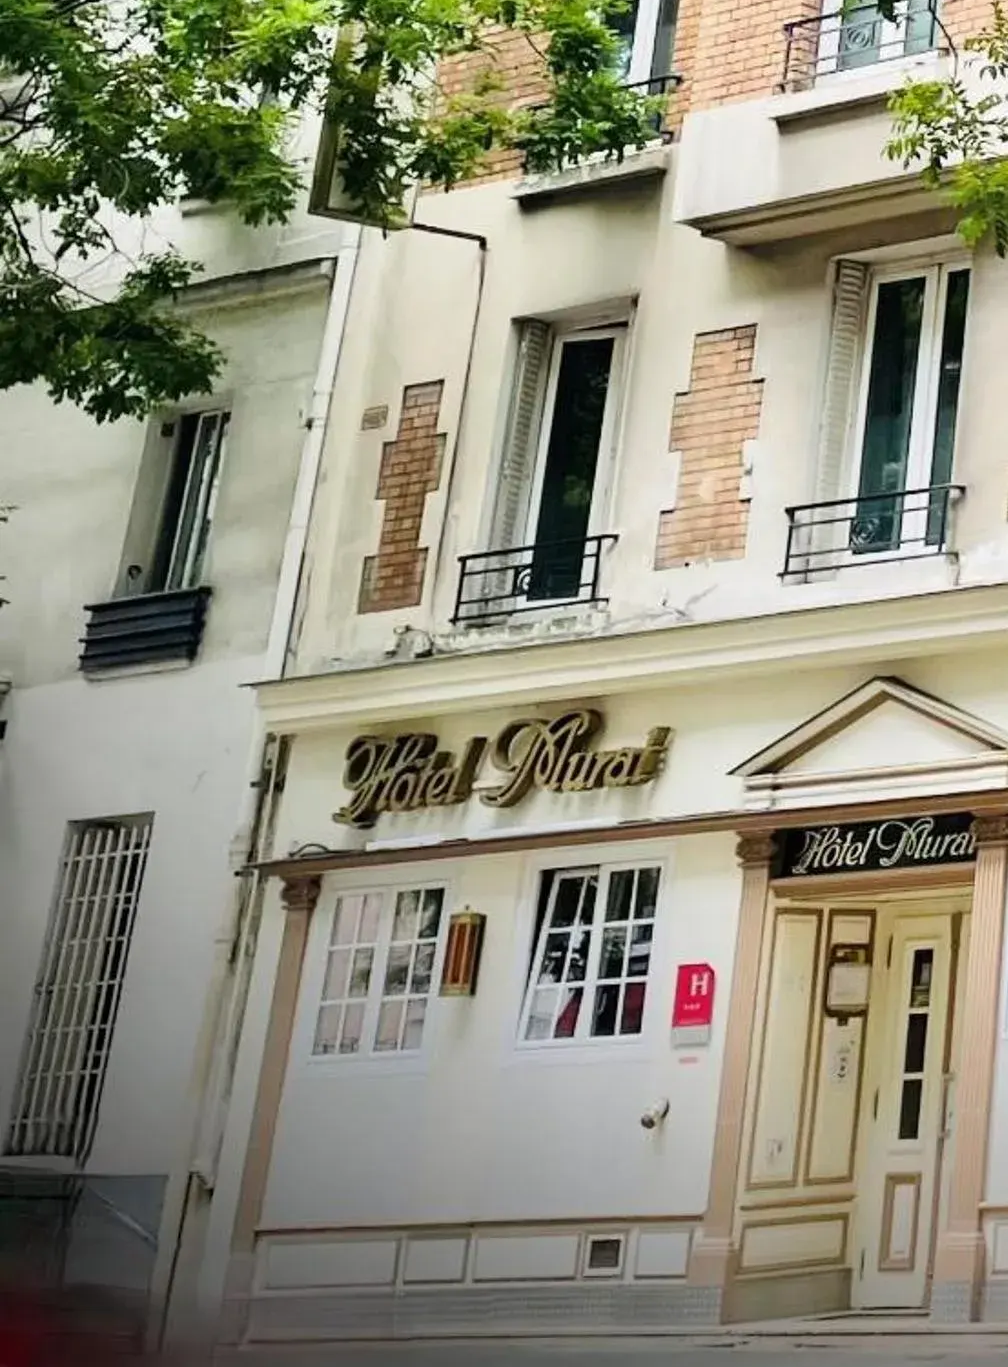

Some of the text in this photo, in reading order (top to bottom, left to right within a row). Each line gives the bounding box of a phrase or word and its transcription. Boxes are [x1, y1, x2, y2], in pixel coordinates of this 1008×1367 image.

[479, 708, 675, 808] Murat
[791, 827, 876, 874] Hôtel
[690, 973, 708, 996] H
